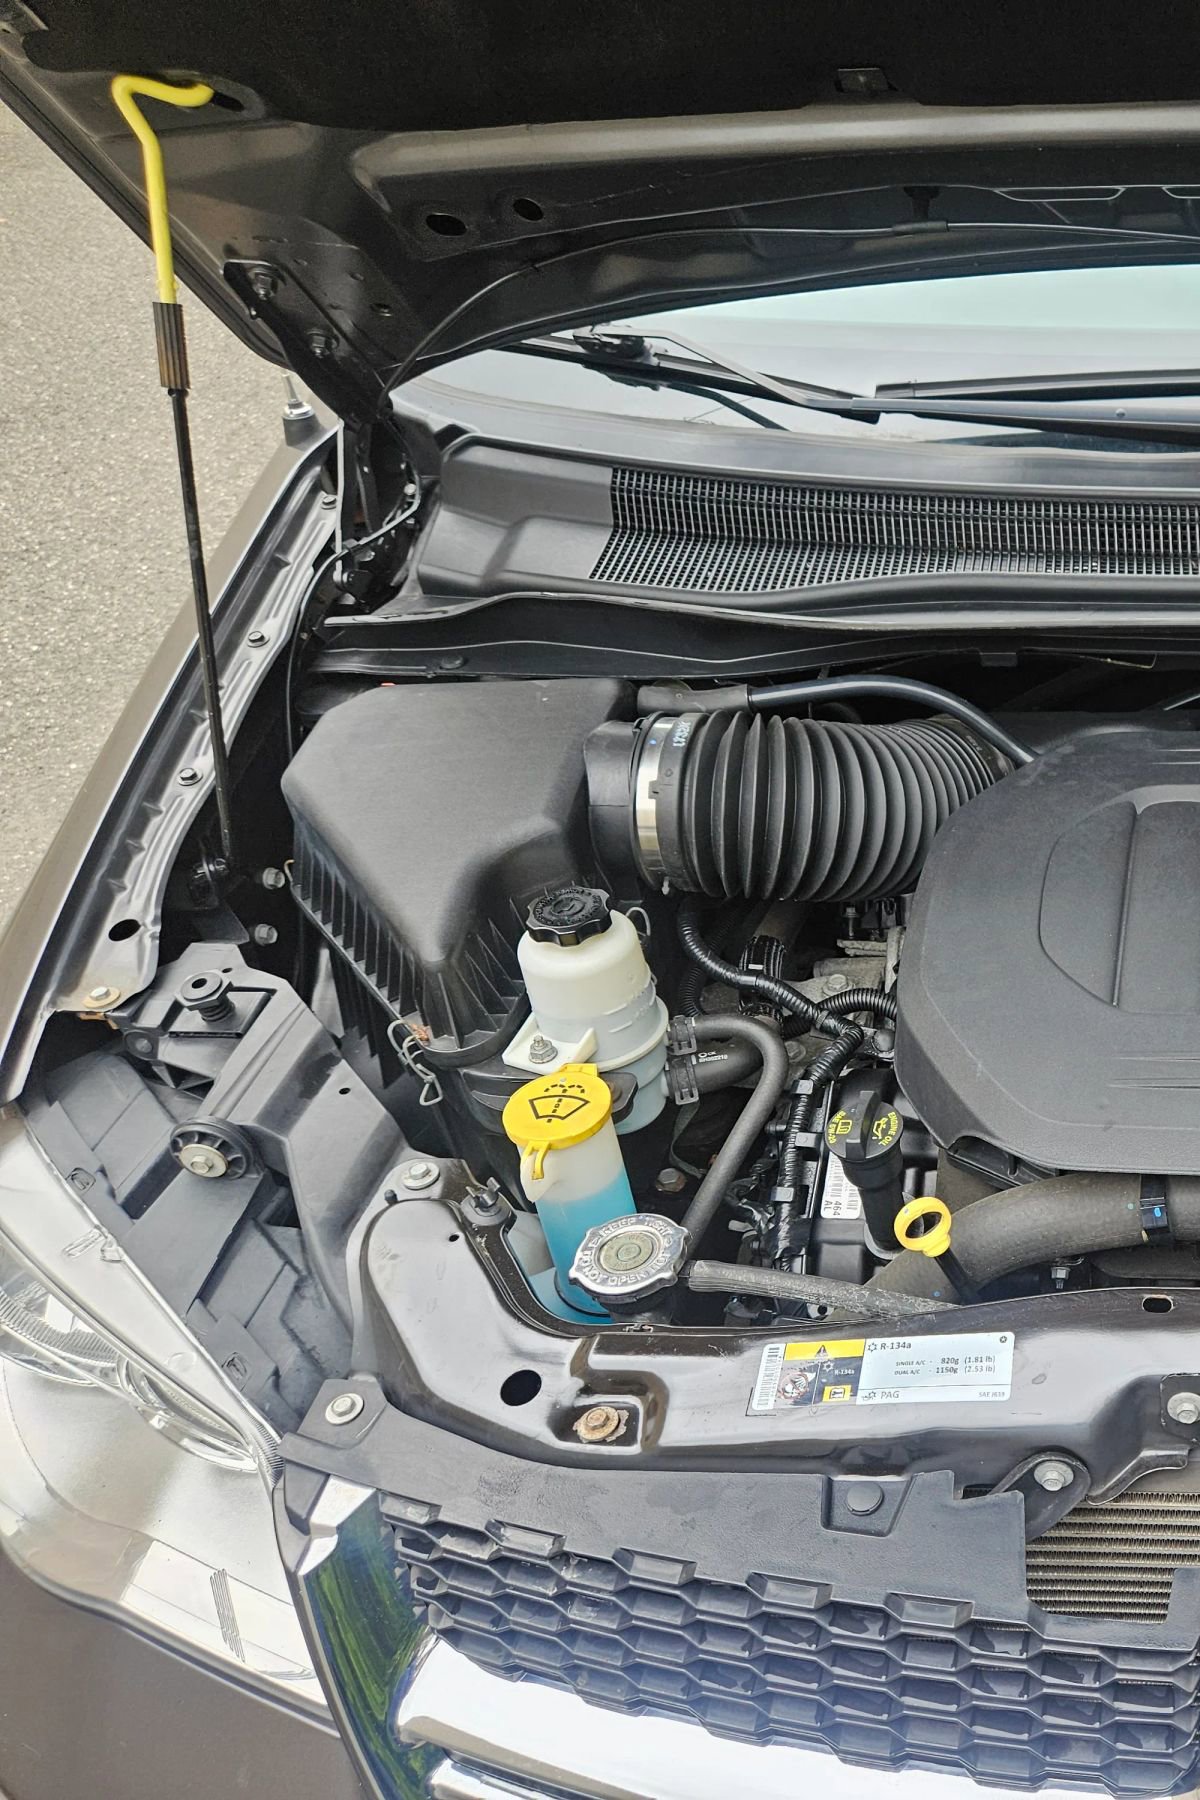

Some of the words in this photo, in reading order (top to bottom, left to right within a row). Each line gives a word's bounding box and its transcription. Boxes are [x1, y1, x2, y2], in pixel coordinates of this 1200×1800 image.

[887, 1111, 899, 1136] ENGINE
[878, 1136, 893, 1146] OIL
[832, 1200, 843, 1216] 464
[598, 1217, 637, 1238] KEEP
[607, 1269, 650, 1287] OPEN
[879, 1341, 912, 1351] R-134a
[940, 1357, 960, 1366] 820g
[964, 1355, 984, 1365] (1.81
[984, 1354, 996, 1364] lb)
[935, 1366, 959, 1375] 1150g
[964, 1364, 984, 1374] (2.53
[984, 1363, 996, 1374] lb)
[880, 1390, 900, 1400] PAG
